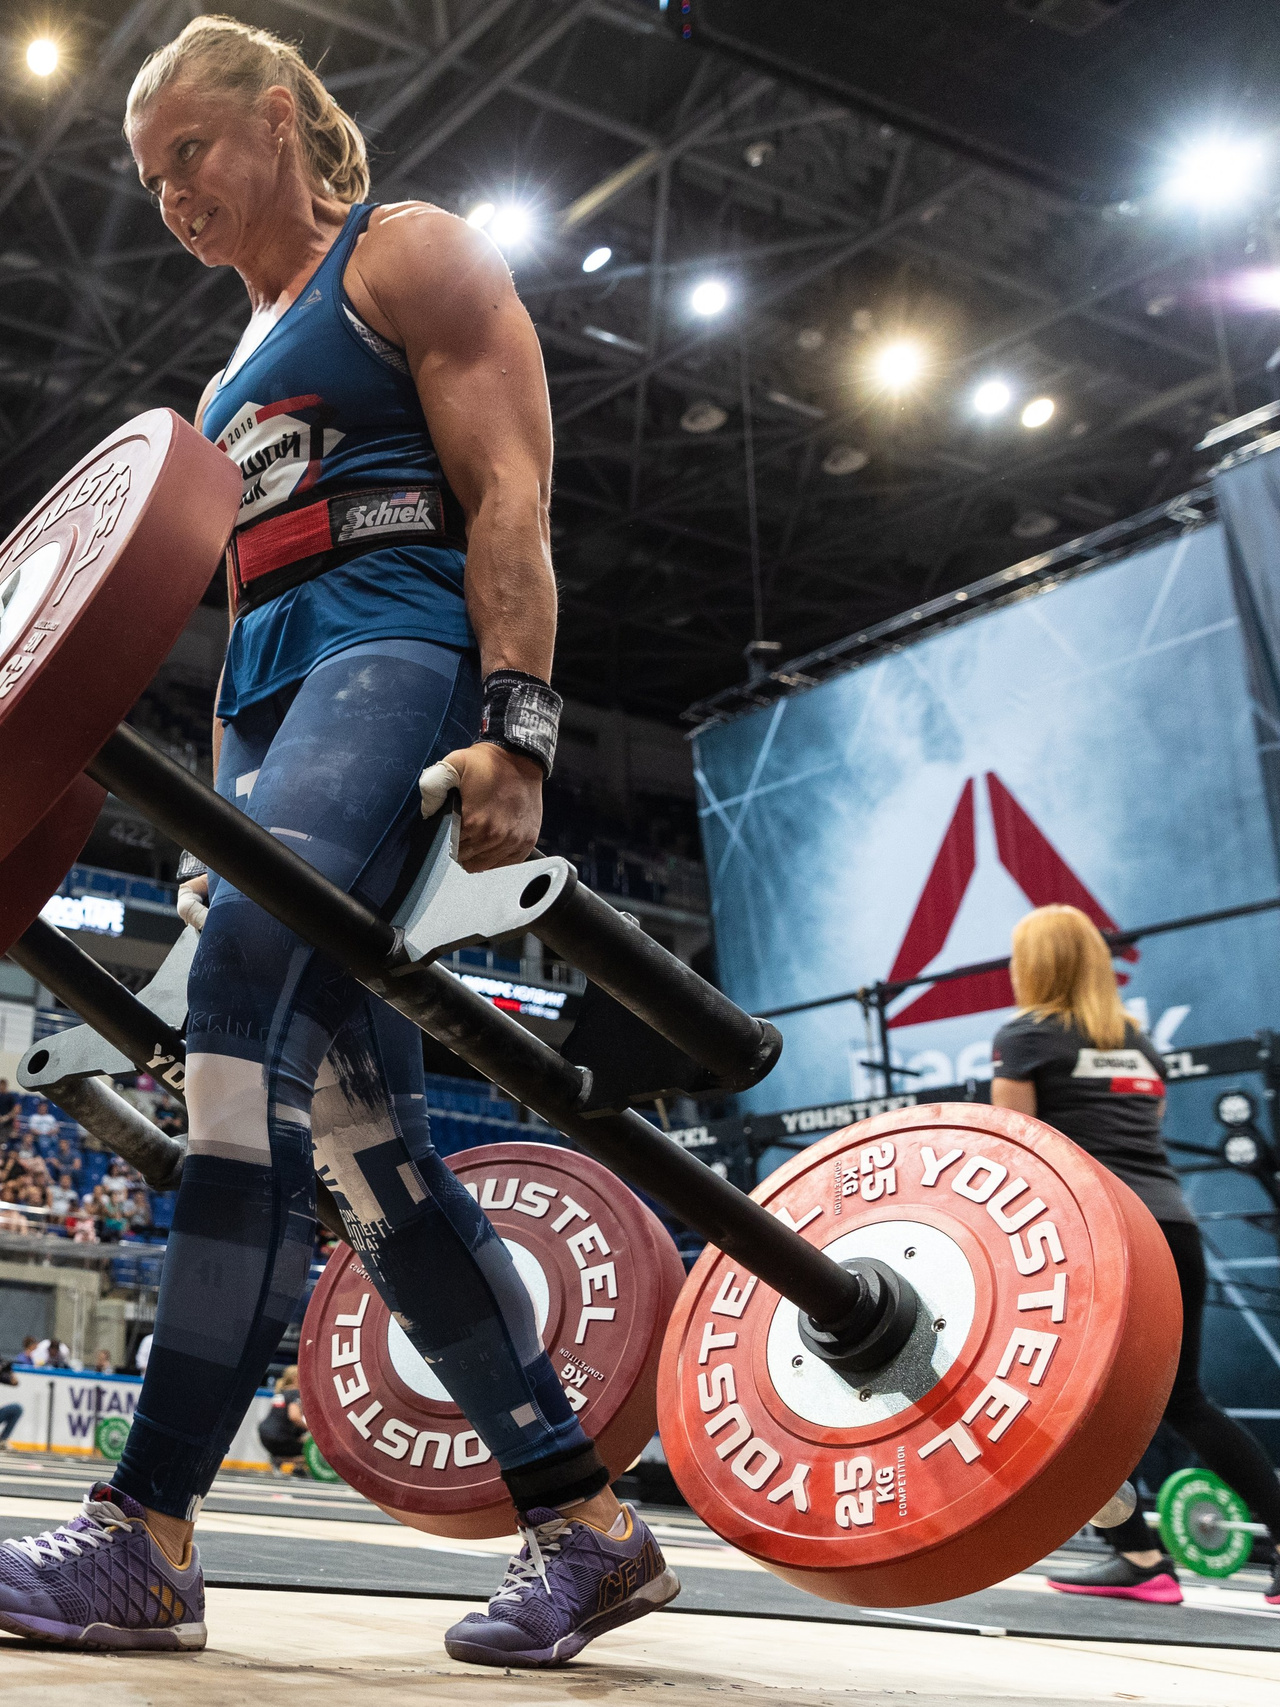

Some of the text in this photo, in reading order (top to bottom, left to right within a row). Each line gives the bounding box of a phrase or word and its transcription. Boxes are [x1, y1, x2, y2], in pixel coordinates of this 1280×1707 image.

[227, 416, 253, 445] 2018
[345, 500, 436, 533] Schiek
[842, 1166, 860, 1198] KG
[861, 1142, 897, 1202] 25
[917, 1145, 1069, 1465] YOUSTEEL
[331, 1293, 491, 1470] OUSTEEL
[559, 1347, 605, 1381] COMPETITION
[560, 1362, 589, 1389] KG
[697, 1203, 823, 1513] YOUSTEL
[834, 1455, 875, 1529] 25
[875, 1465, 896, 1504] KG
[897, 1445, 908, 1517] COMPETITION
